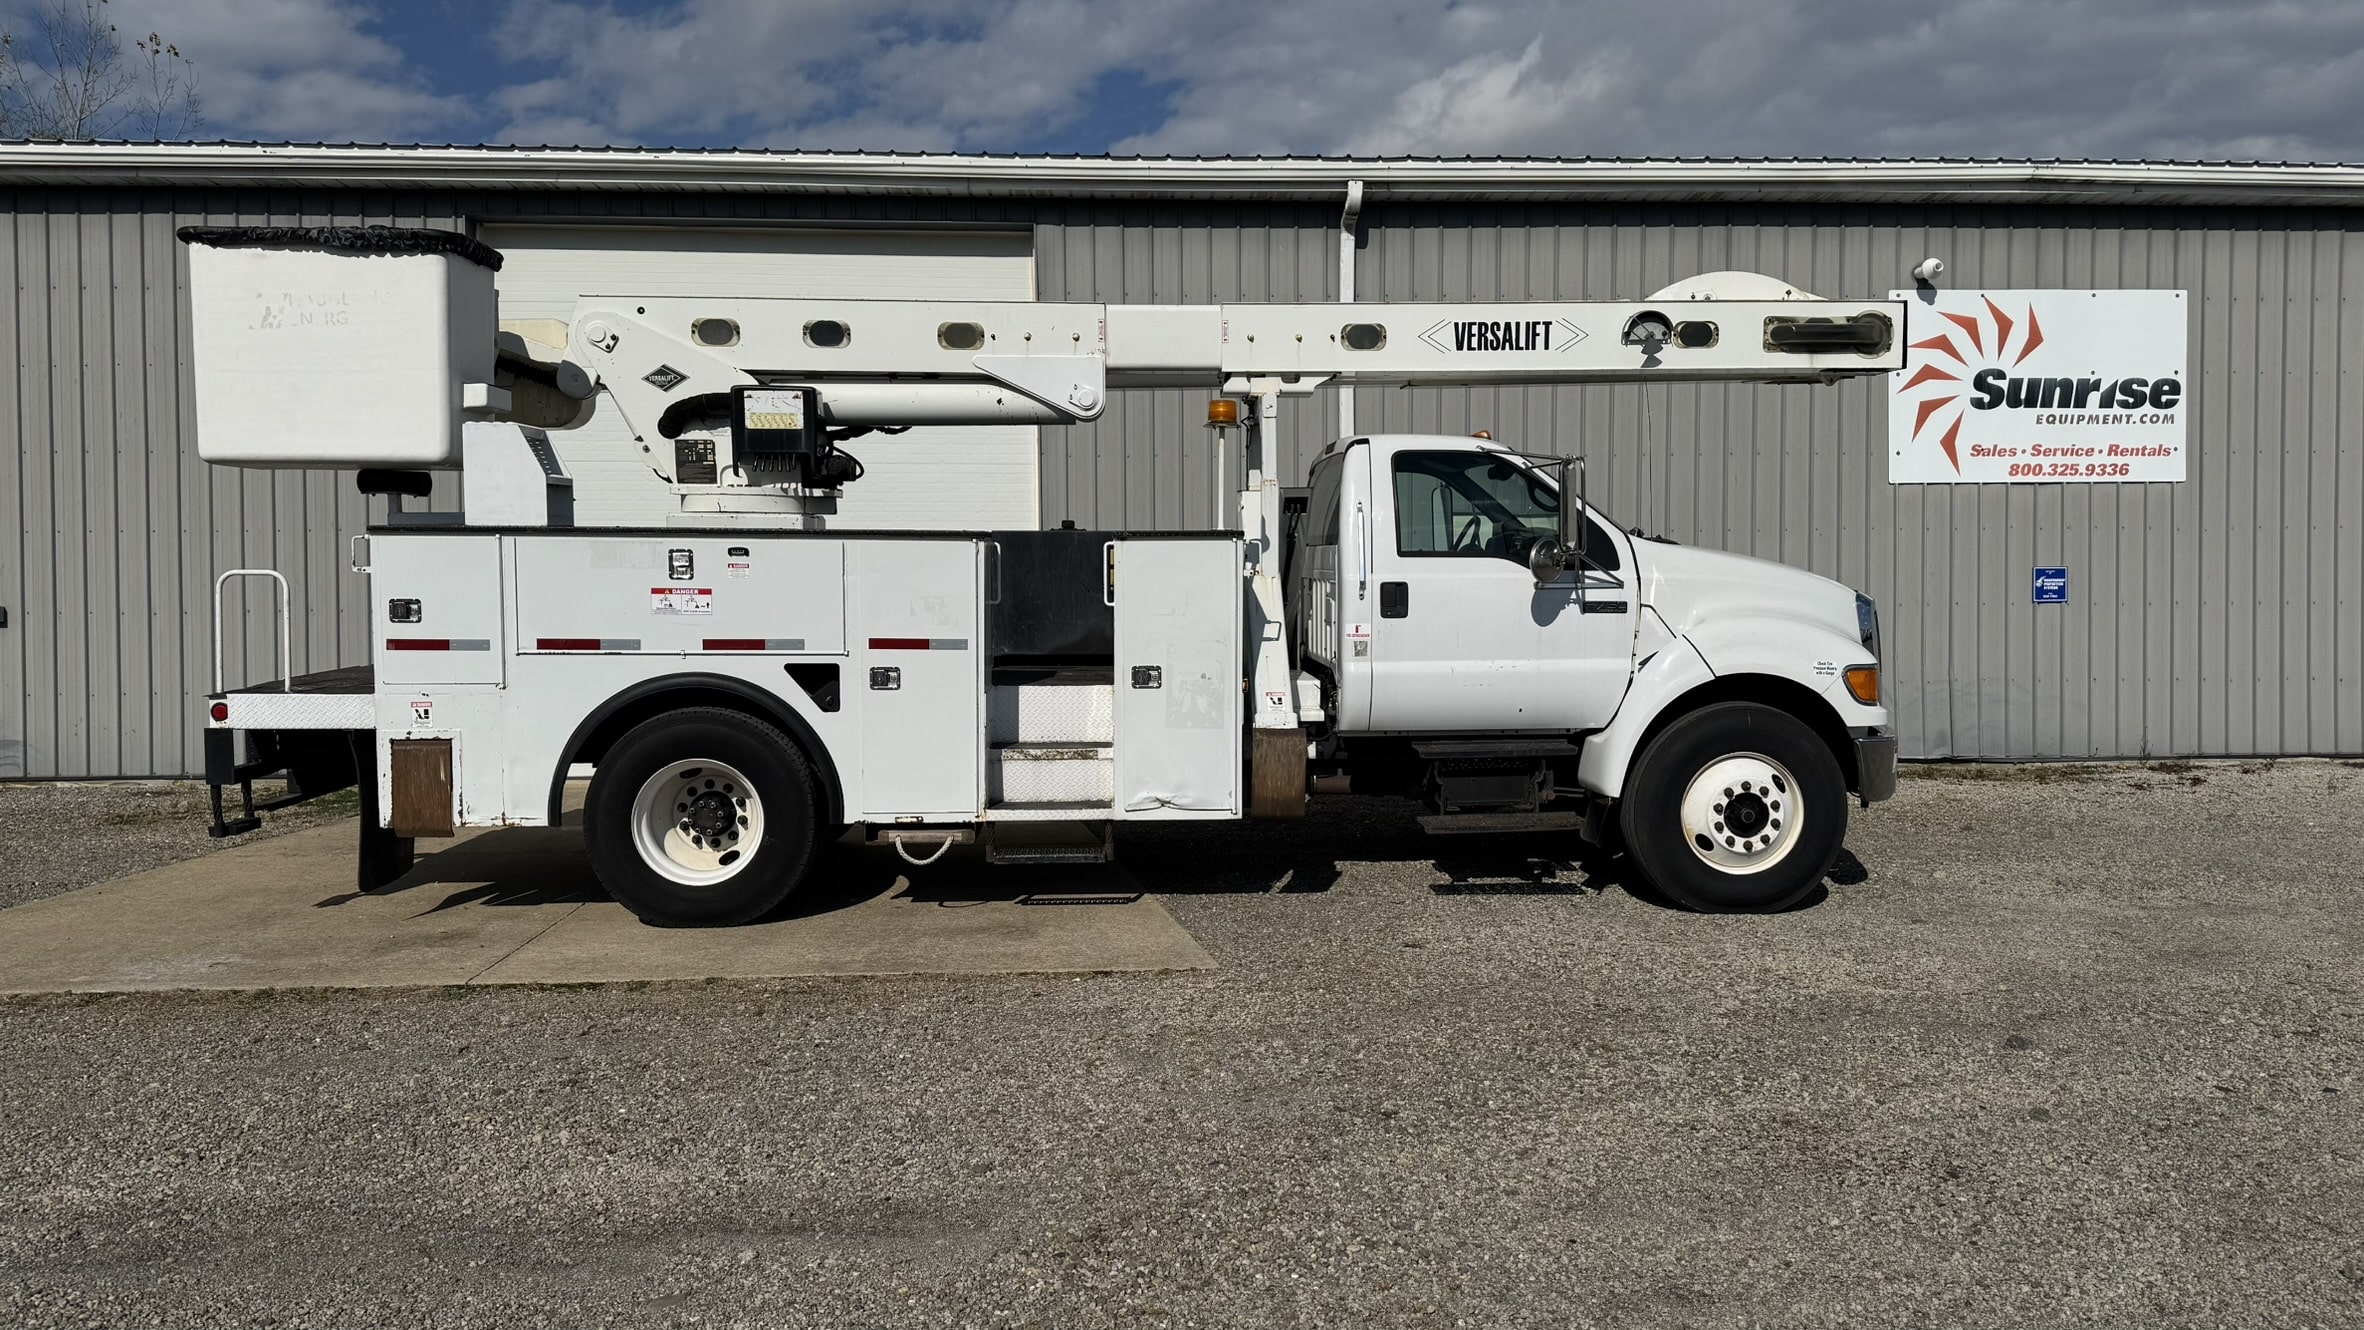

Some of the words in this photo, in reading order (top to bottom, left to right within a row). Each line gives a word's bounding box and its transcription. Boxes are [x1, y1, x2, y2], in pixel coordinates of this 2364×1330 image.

[1453, 321, 1553, 351] VERSALIFT
[1970, 368, 2182, 410] Sunrise
[2035, 414, 2175, 425] EQUIPMENT.COM
[1970, 444, 2018, 457] Sales
[2030, 444, 2095, 457] Service
[2107, 444, 2171, 457] Rentals
[2008, 463, 2130, 476] 800.325.9336
